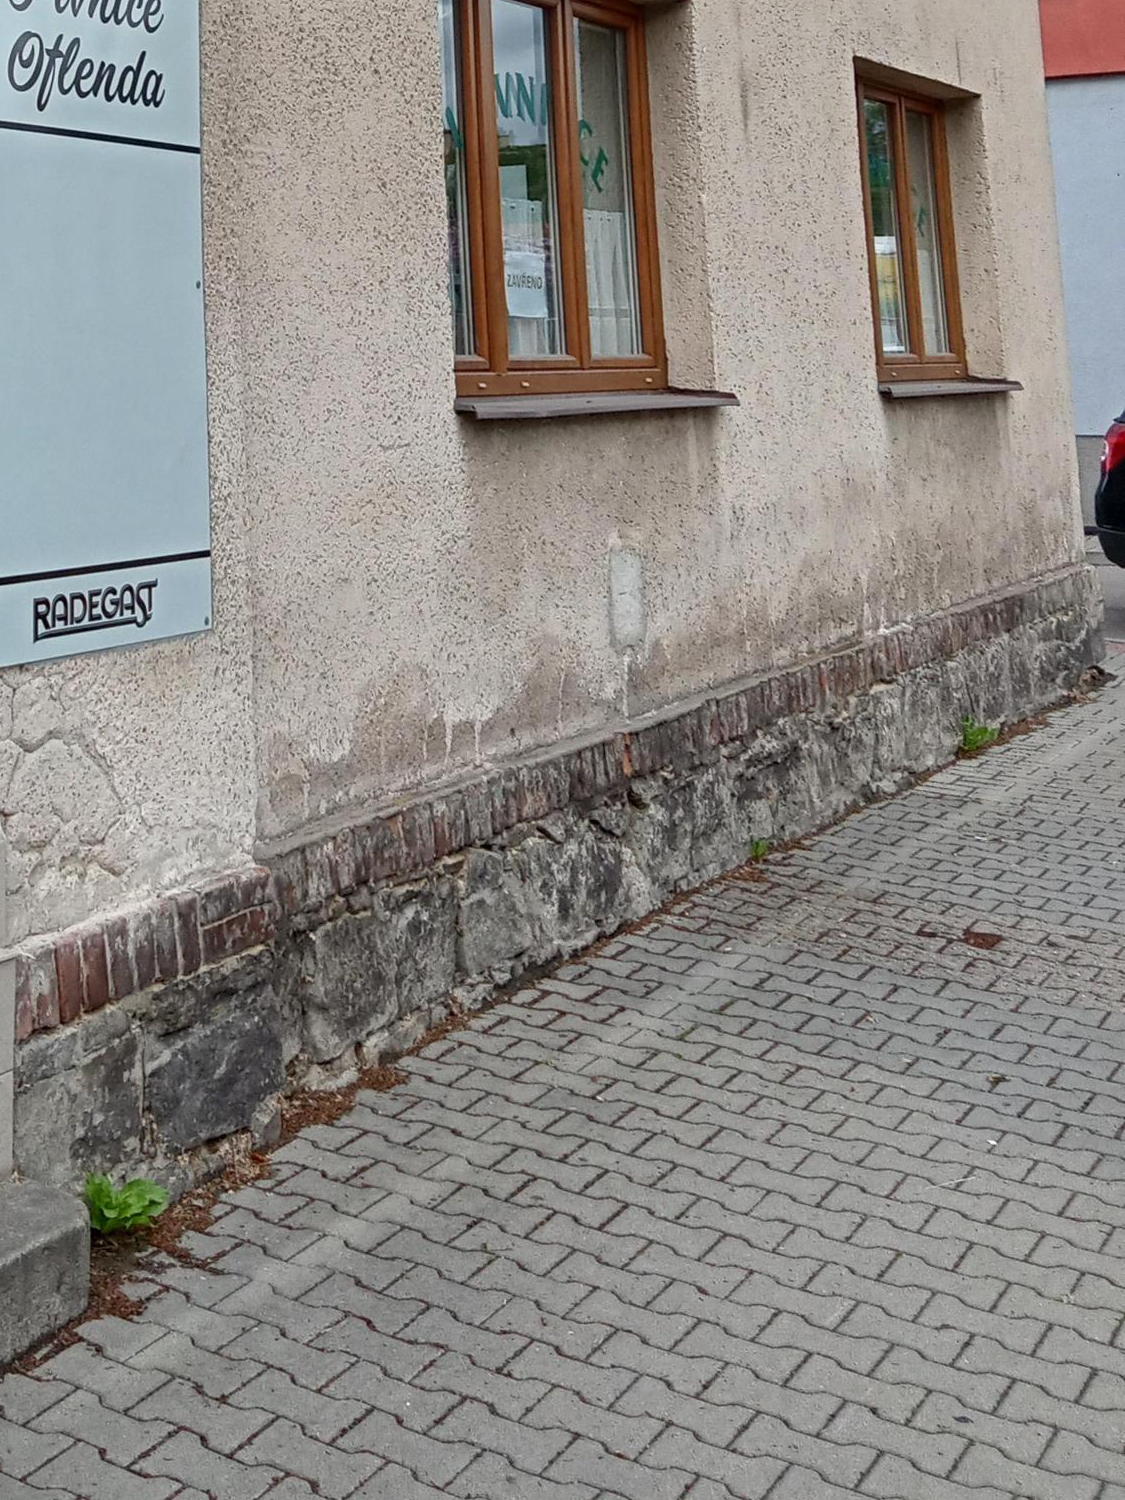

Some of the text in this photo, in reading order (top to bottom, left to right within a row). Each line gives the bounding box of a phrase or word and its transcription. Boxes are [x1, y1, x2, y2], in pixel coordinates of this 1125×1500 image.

[7, 31, 165, 112] Oflenda
[506, 272, 544, 291] ZAVŘENO
[33, 578, 158, 643] RADEGAST
